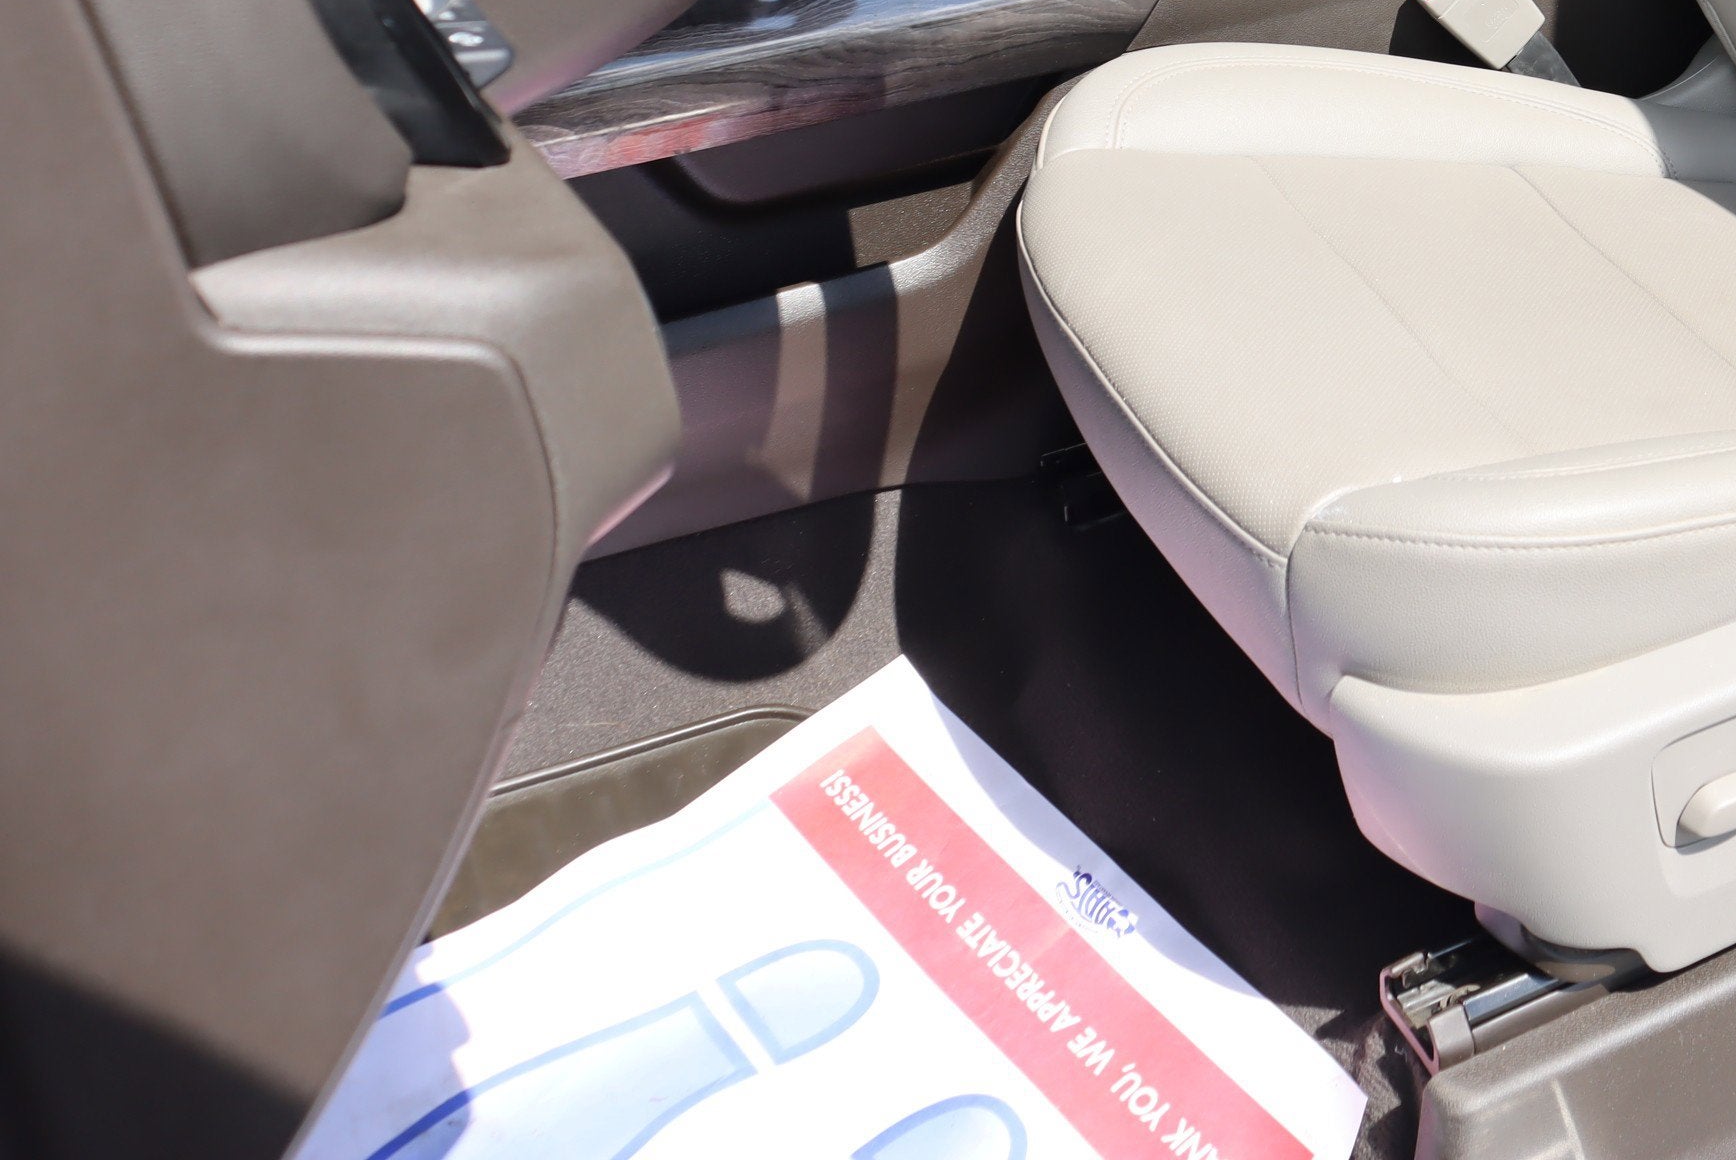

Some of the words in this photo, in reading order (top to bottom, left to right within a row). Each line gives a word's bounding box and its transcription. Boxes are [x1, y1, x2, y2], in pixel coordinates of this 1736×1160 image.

[819, 769, 918, 868] BUSINESS!
[906, 858, 966, 924] YOUR
[956, 912, 1081, 1033] APPRECIATE
[1066, 1026, 1115, 1076] WE
[1110, 1063, 1170, 1132] YOU,
